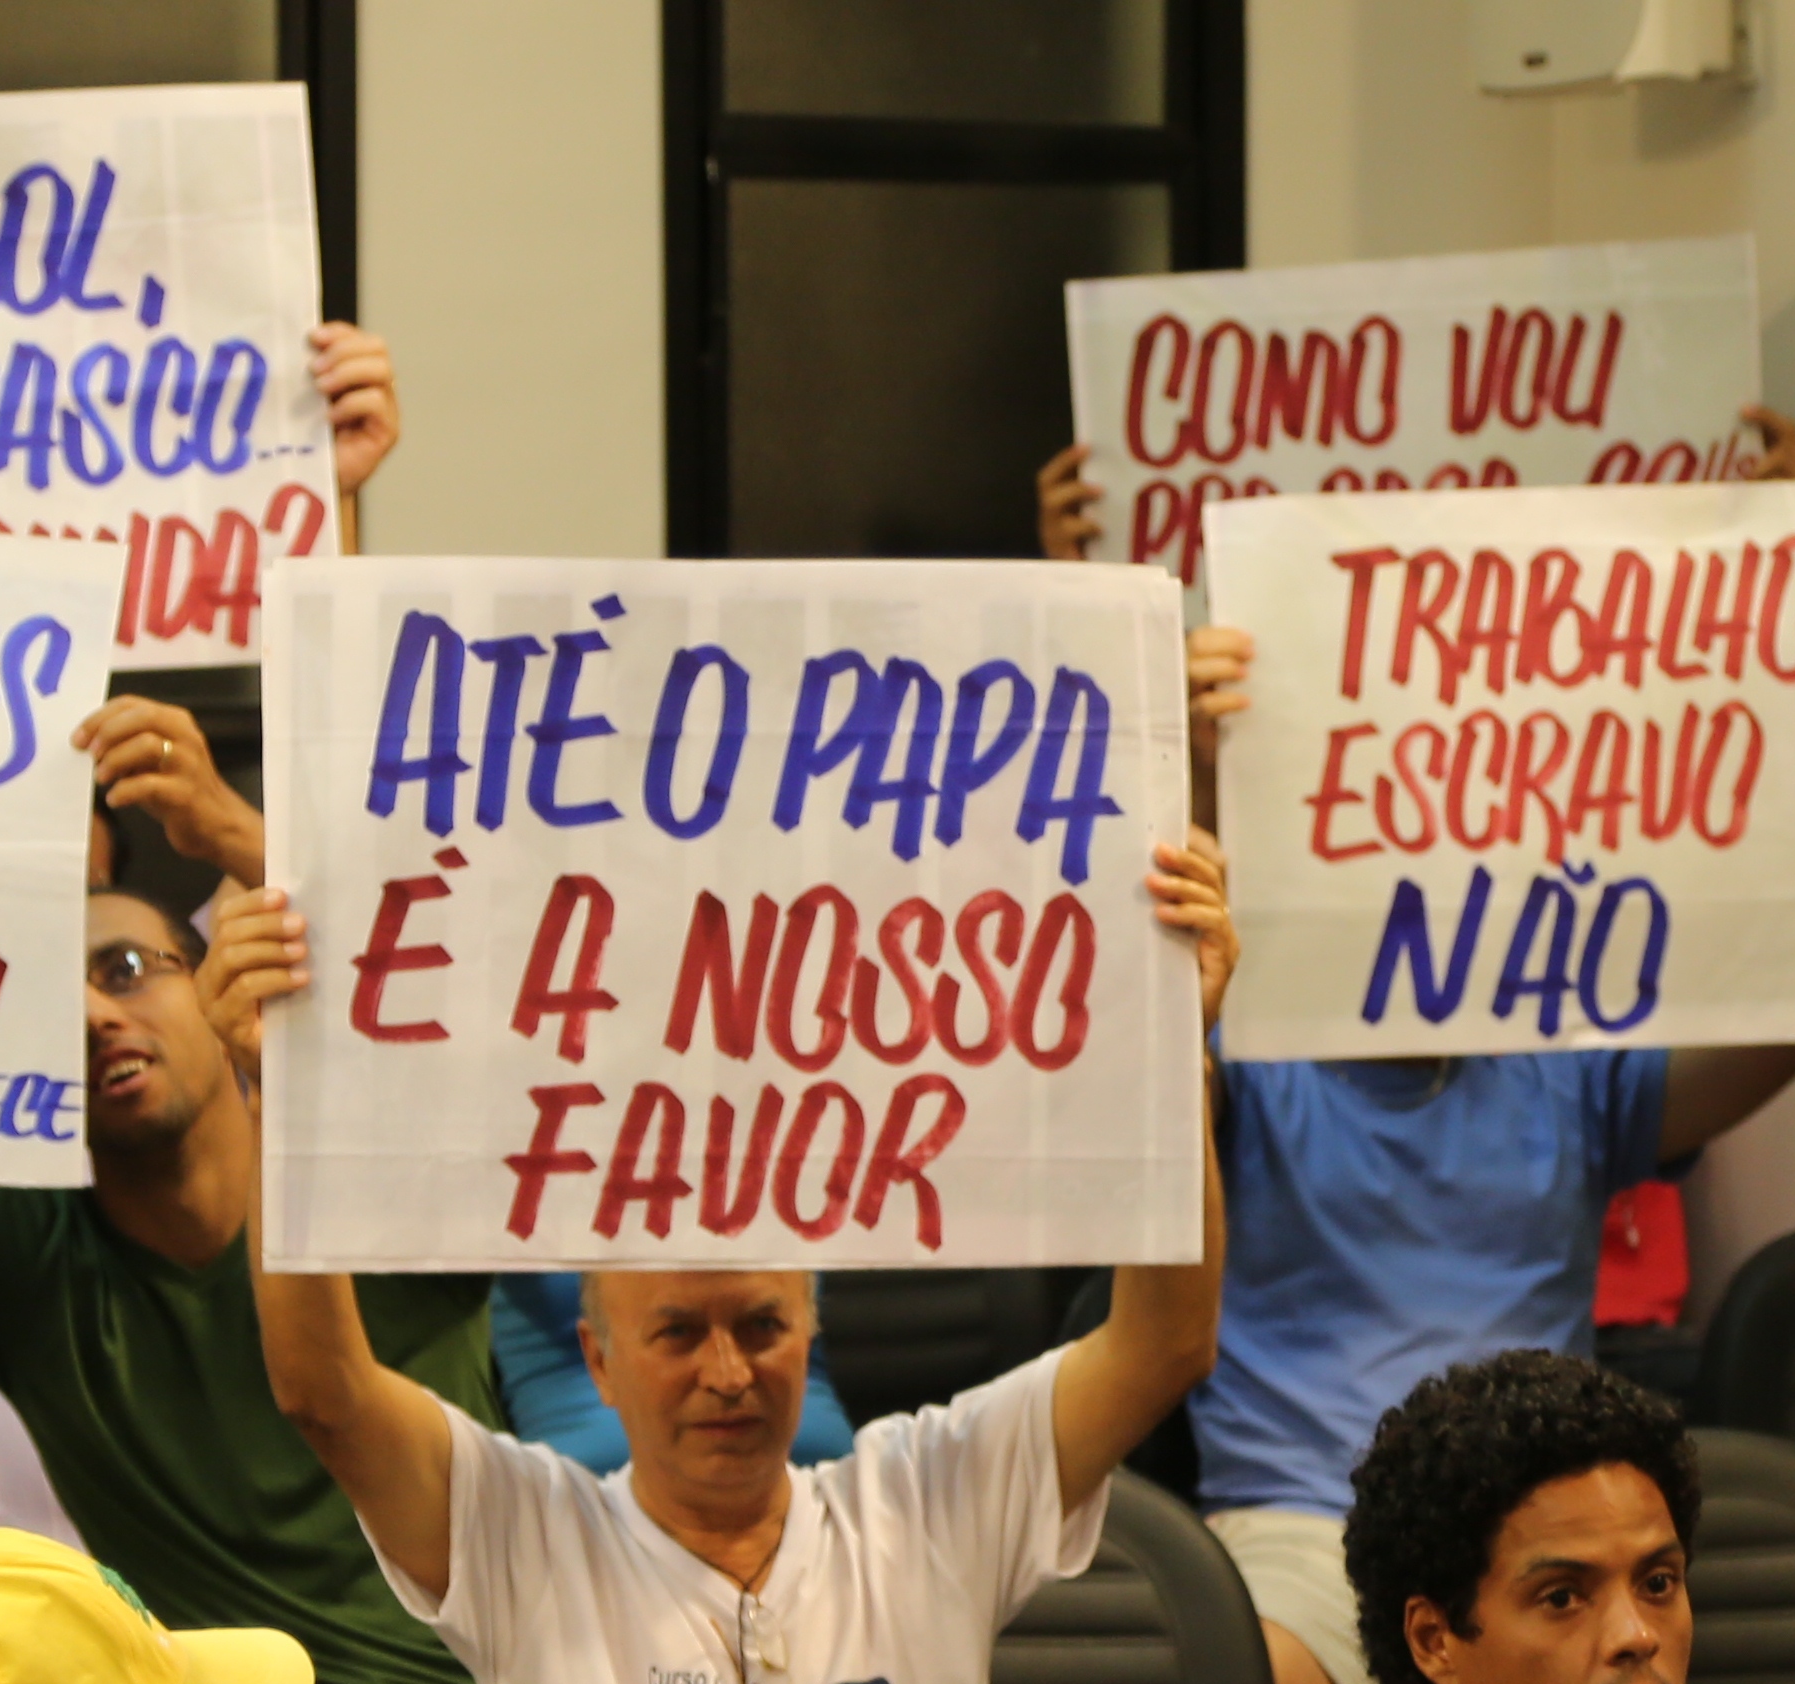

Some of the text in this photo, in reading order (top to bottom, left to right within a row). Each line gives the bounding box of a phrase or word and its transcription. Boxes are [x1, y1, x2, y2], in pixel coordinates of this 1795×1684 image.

[1125, 304, 1625, 468] COMO VOU
[365, 593, 1126, 887] ATÉ O PAPA
[1303, 700, 1765, 865] ESCRAVO
[349, 847, 1097, 1073] É A NOSSO
[1361, 861, 1671, 1039] NÃO
[503, 1073, 967, 1252] FAVOR
